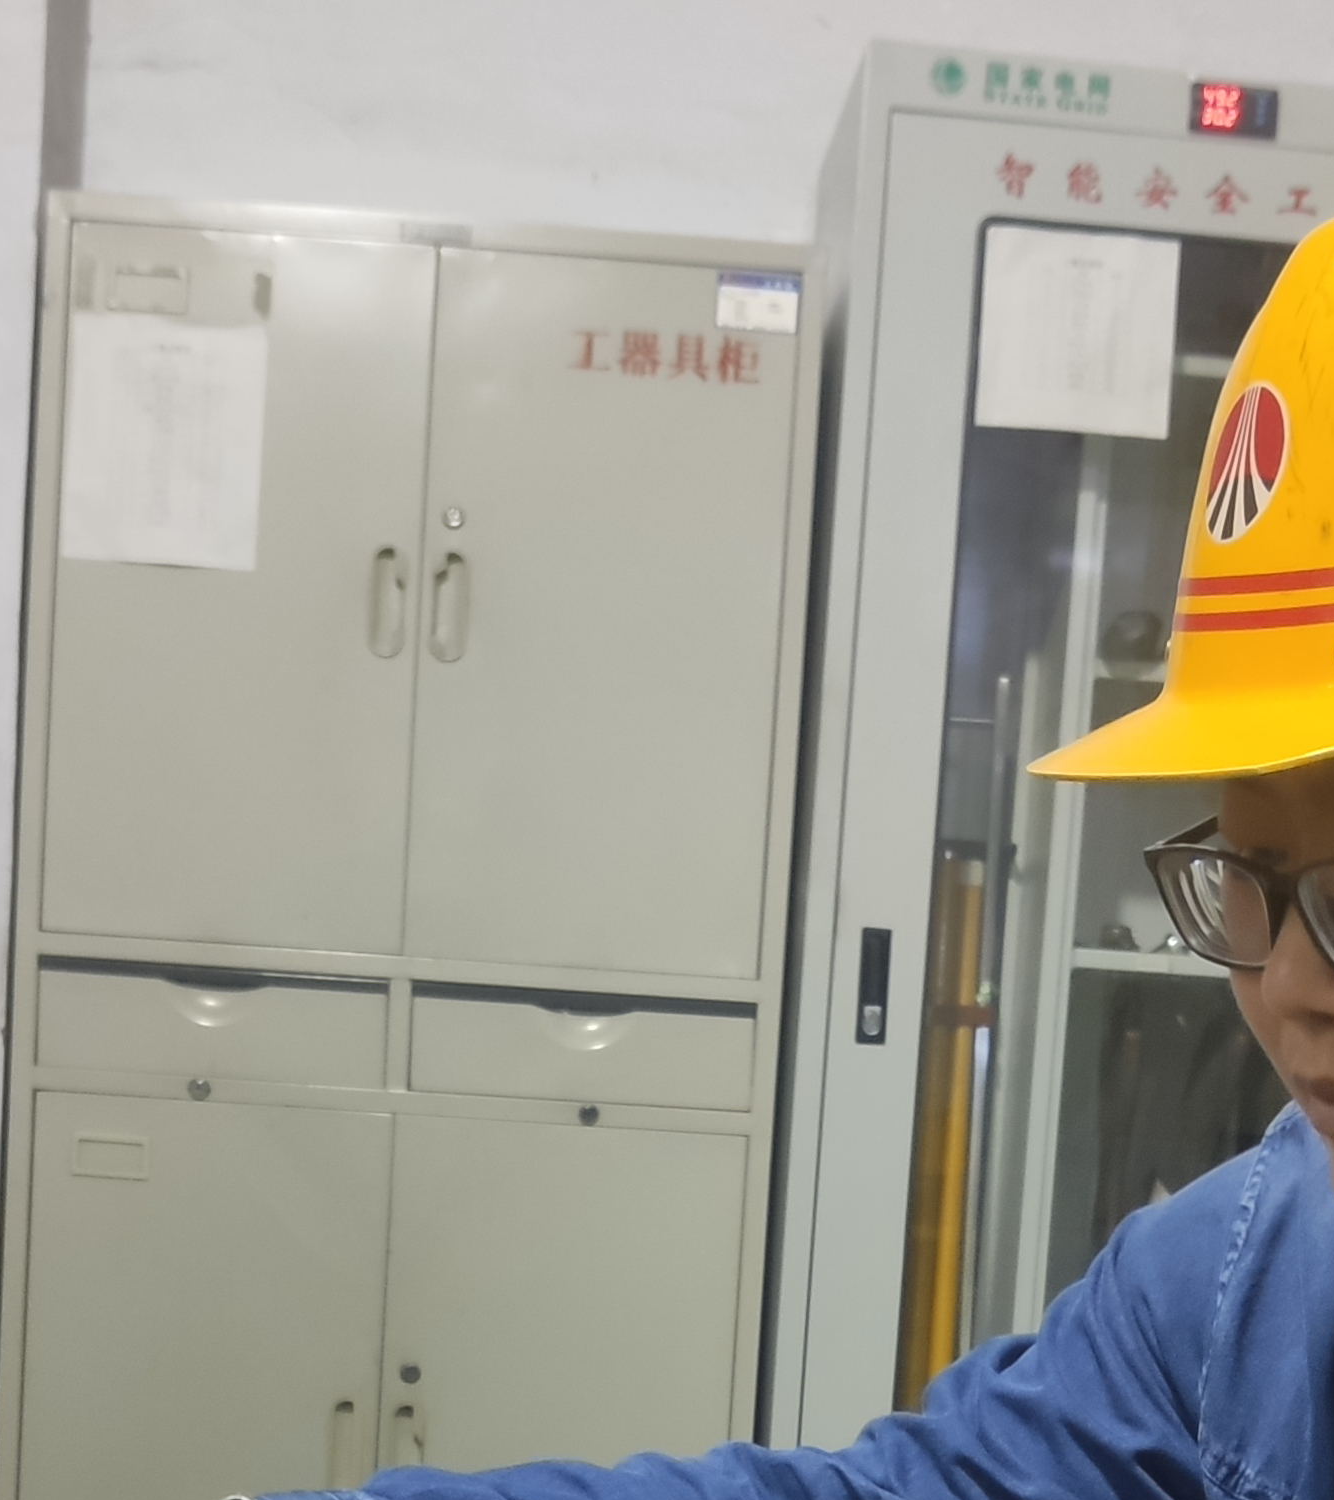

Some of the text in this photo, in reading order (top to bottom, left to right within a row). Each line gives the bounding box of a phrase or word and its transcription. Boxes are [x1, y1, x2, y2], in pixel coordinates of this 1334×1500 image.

[986, 61, 1111, 97] 国家电网
[568, 330, 762, 384] 工器具柜
